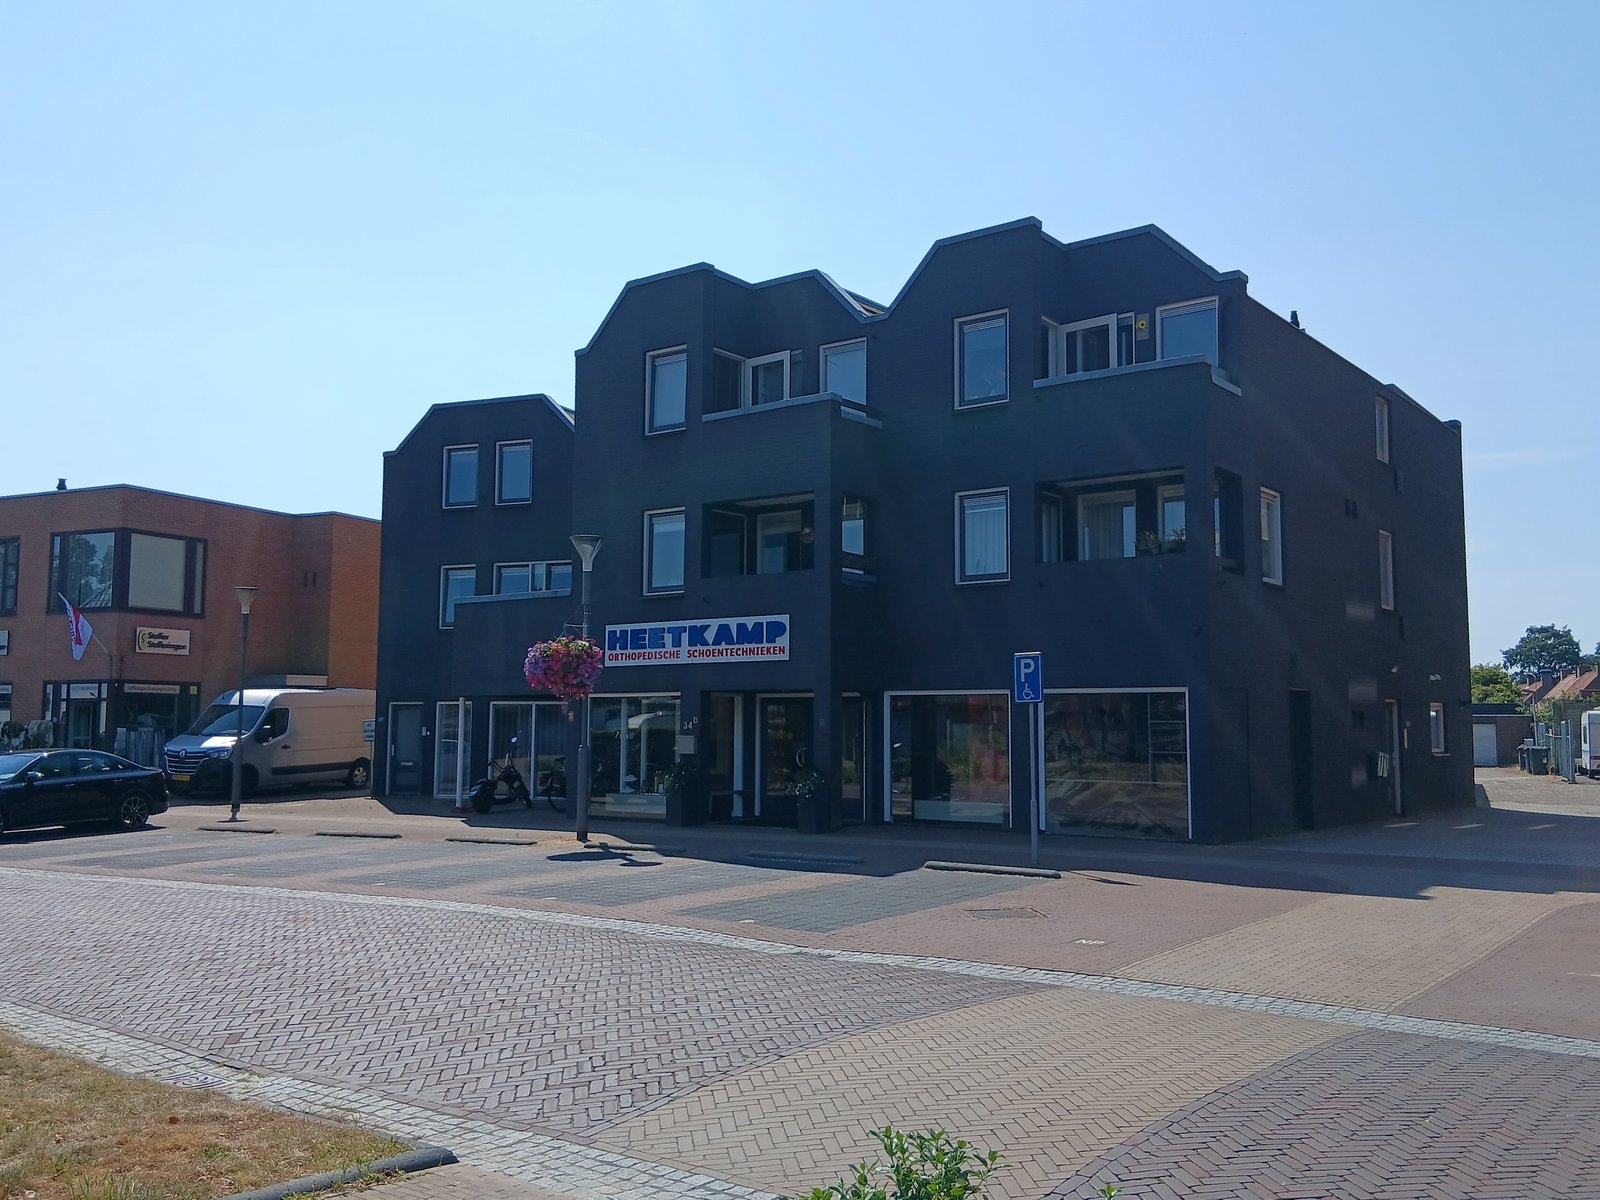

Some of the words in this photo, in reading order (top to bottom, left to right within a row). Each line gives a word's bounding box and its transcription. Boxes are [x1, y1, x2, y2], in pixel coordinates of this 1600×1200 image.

[608, 621, 787, 651] HEETKAMP
[608, 650, 681, 662] ORTHOPEDISCHE
[686, 645, 786, 659] SCHOENTECHNIEKEN
[1020, 658, 1035, 682] P
